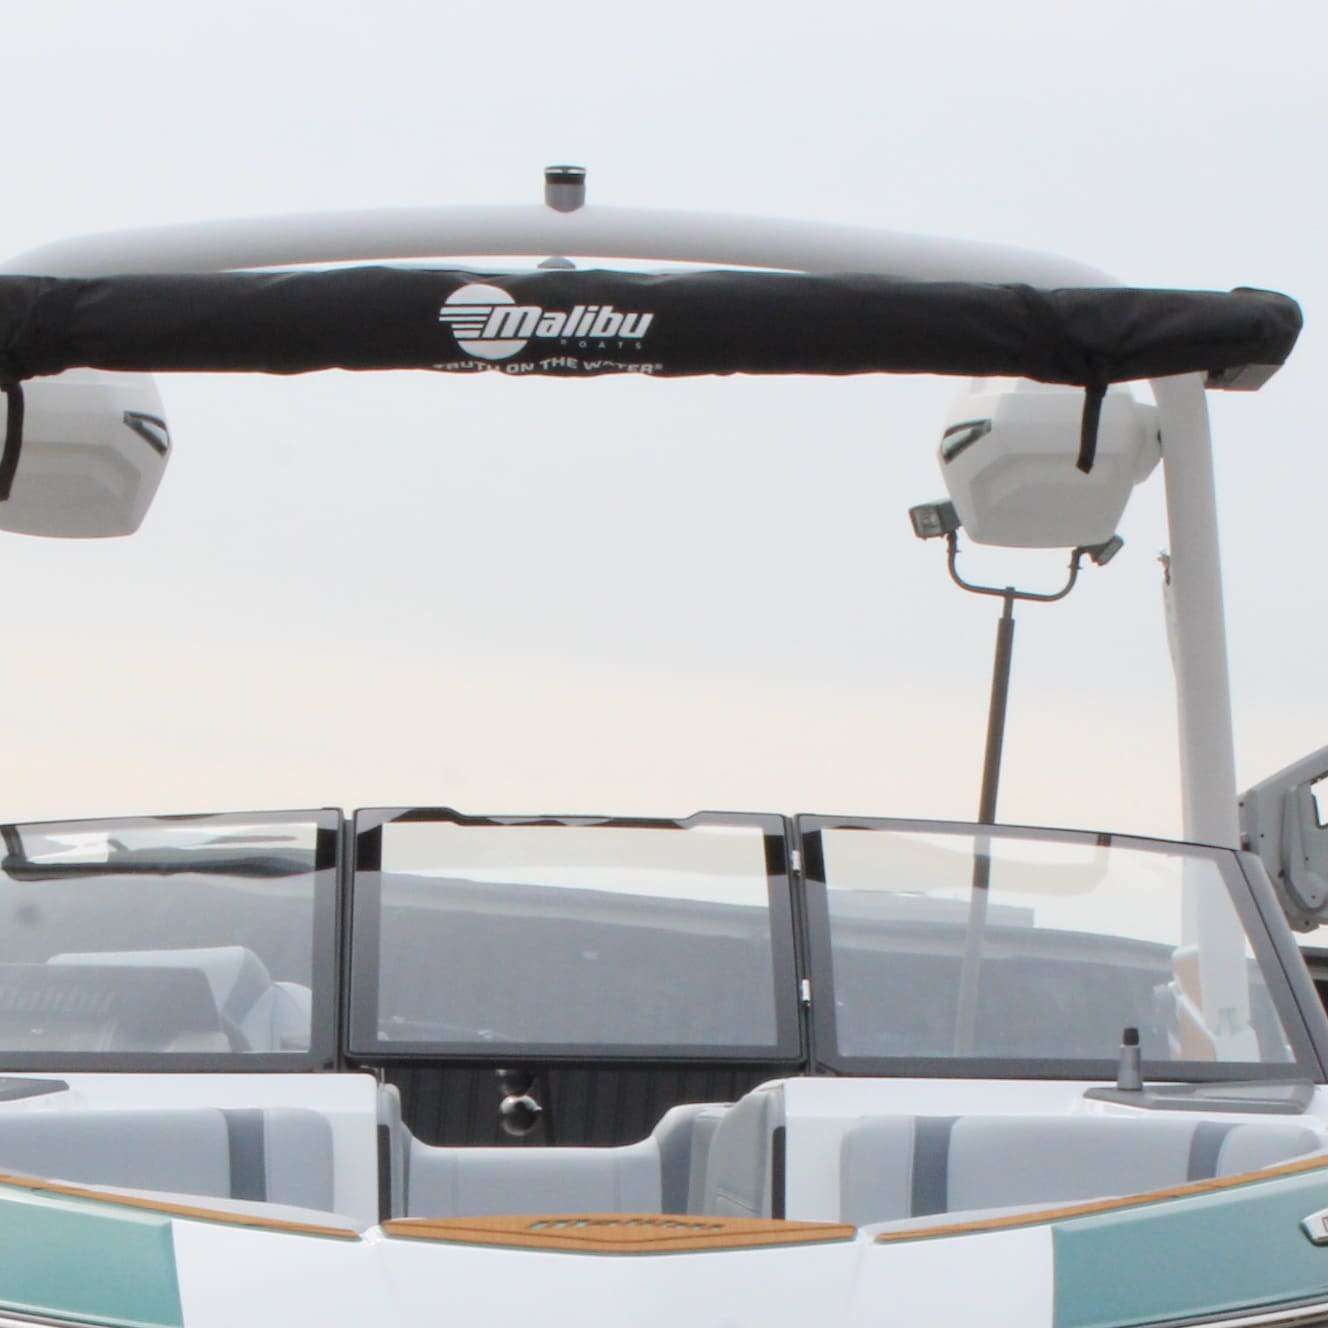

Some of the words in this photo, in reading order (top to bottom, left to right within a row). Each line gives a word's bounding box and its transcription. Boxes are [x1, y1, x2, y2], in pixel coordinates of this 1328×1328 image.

[481, 304, 655, 339] Malibu
[561, 339, 643, 350] BOATS
[506, 362, 535, 374] ON
[540, 356, 578, 370] THE
